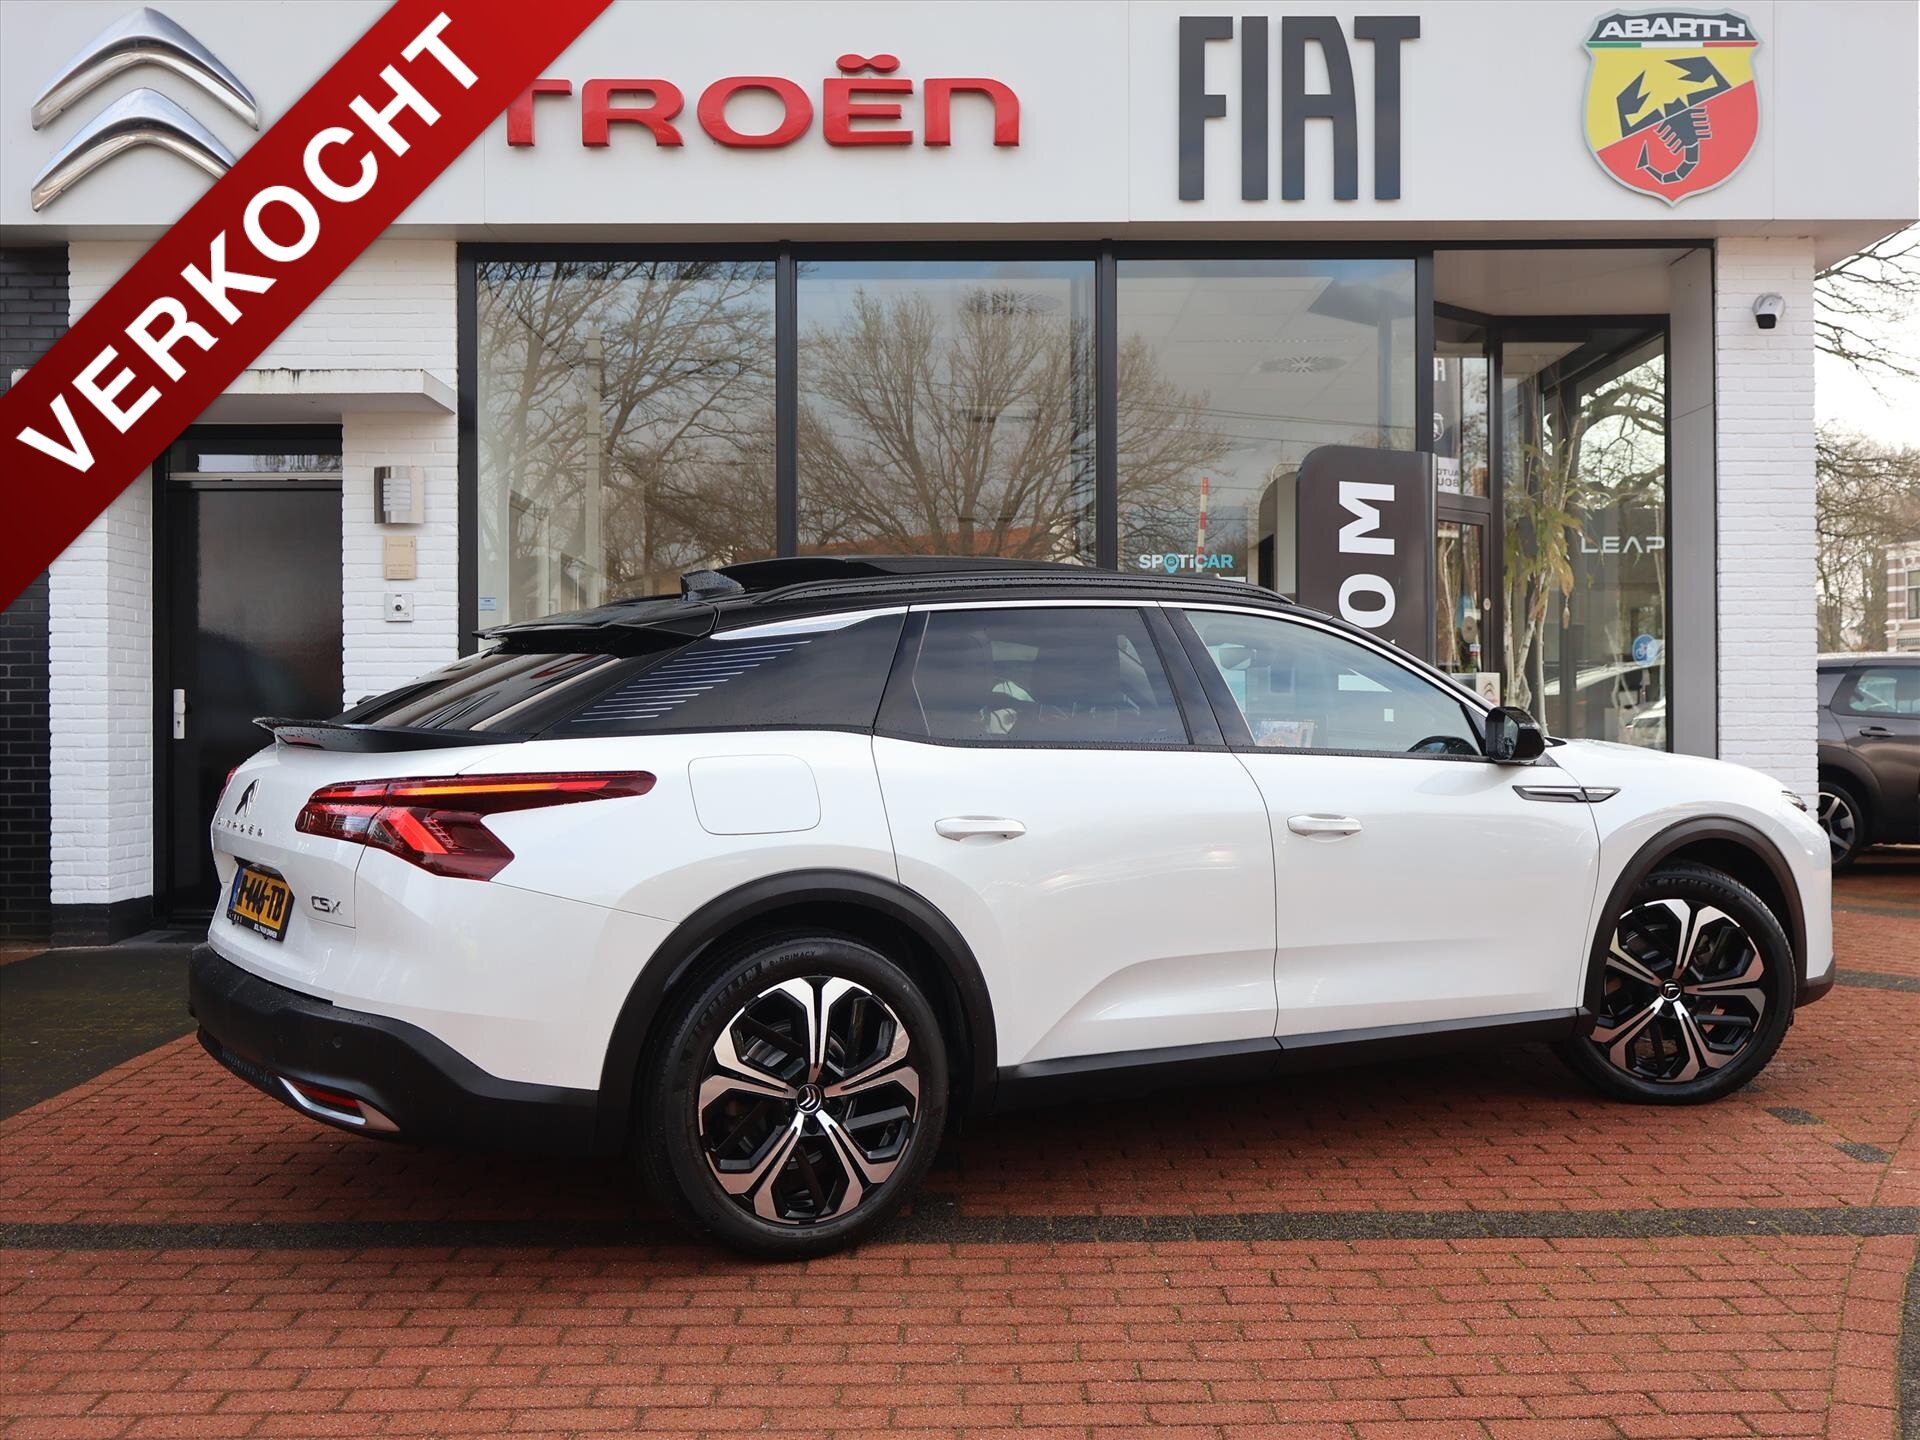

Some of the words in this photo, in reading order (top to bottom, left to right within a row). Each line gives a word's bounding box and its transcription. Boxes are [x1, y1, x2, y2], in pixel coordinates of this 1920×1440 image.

[1599, 18, 1746, 38] ABARTH
[506, 54, 1021, 147] TROËN
[1179, 16, 1421, 201] FIAT
